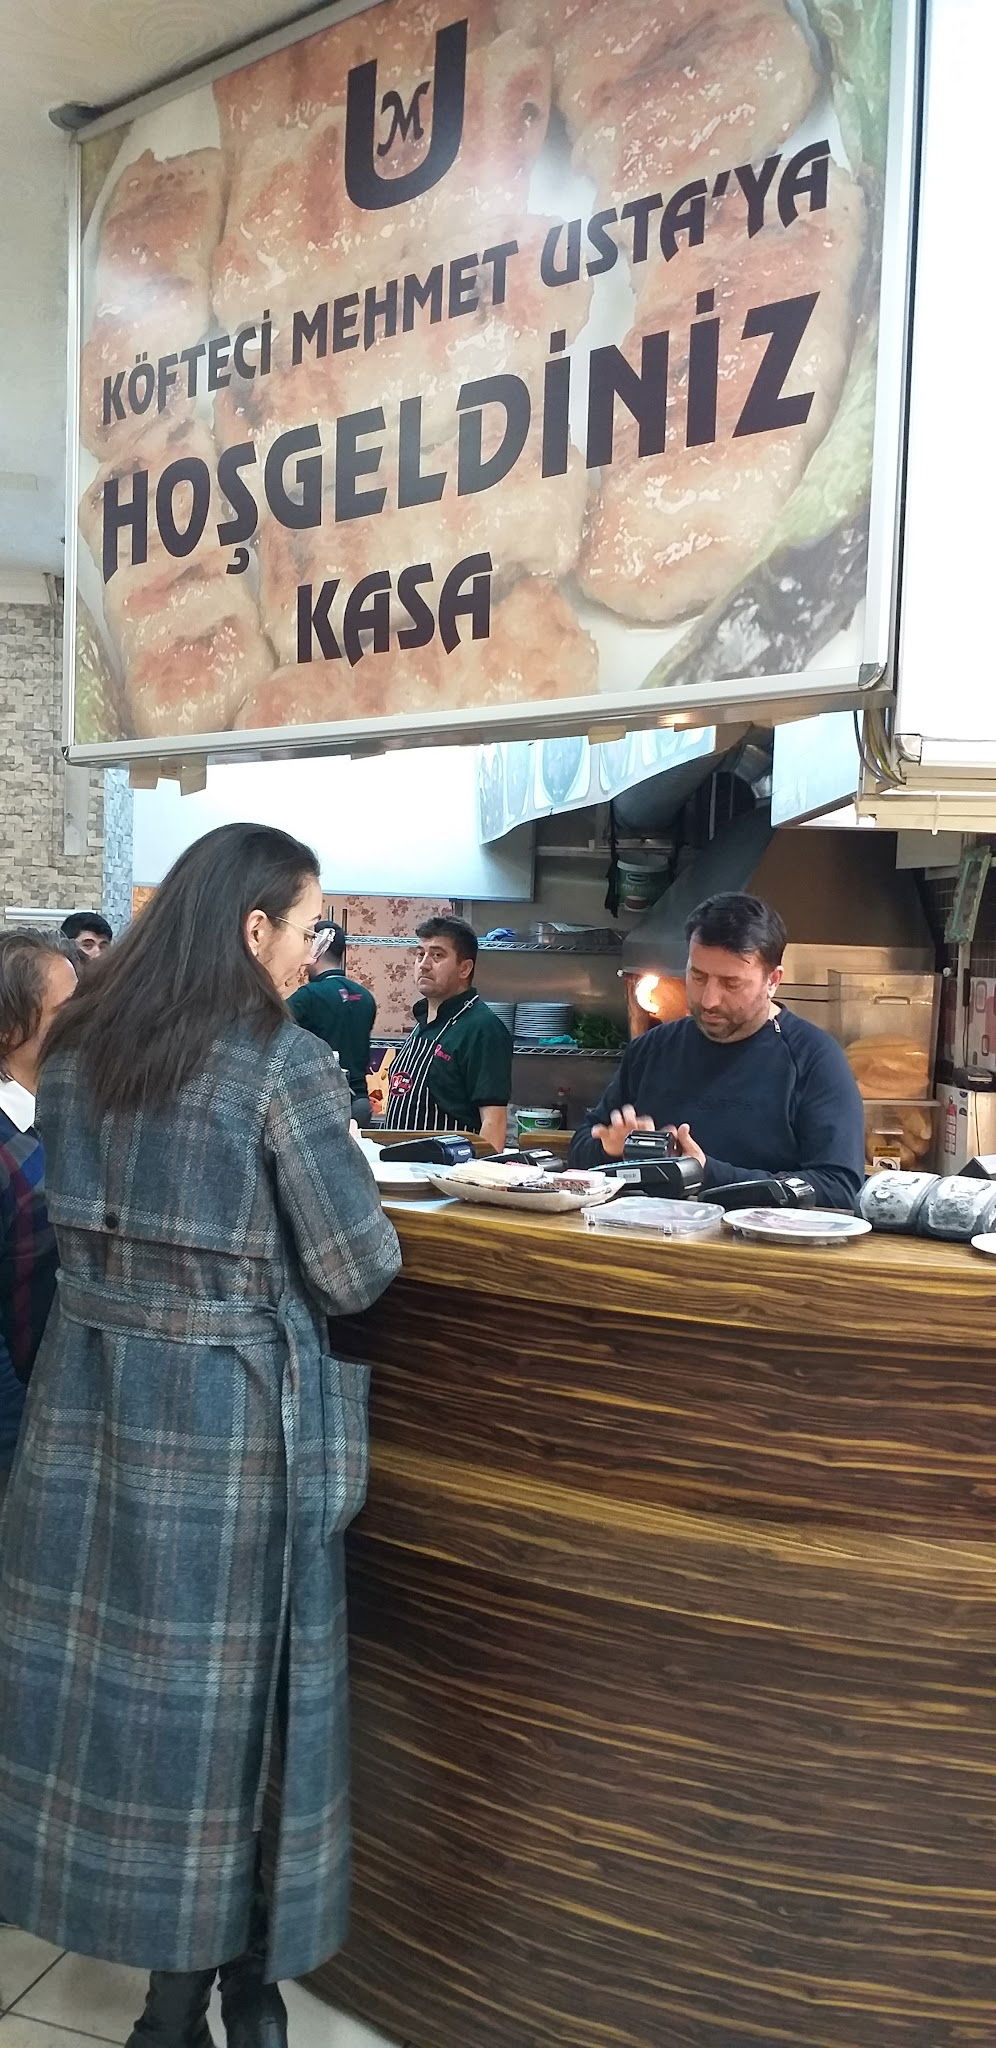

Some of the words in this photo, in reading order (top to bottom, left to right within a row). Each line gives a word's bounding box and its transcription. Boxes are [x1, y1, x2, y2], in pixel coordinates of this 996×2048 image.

[344, 18, 469, 211] U
[376, 80, 431, 157] M
[102, 308, 272, 426] KÖFTECİ
[291, 240, 520, 367] MEHMET
[539, 139, 832, 289] USTA'YA
[102, 289, 821, 586] HOŞGELDİNİZ
[296, 551, 493, 668] KASA
